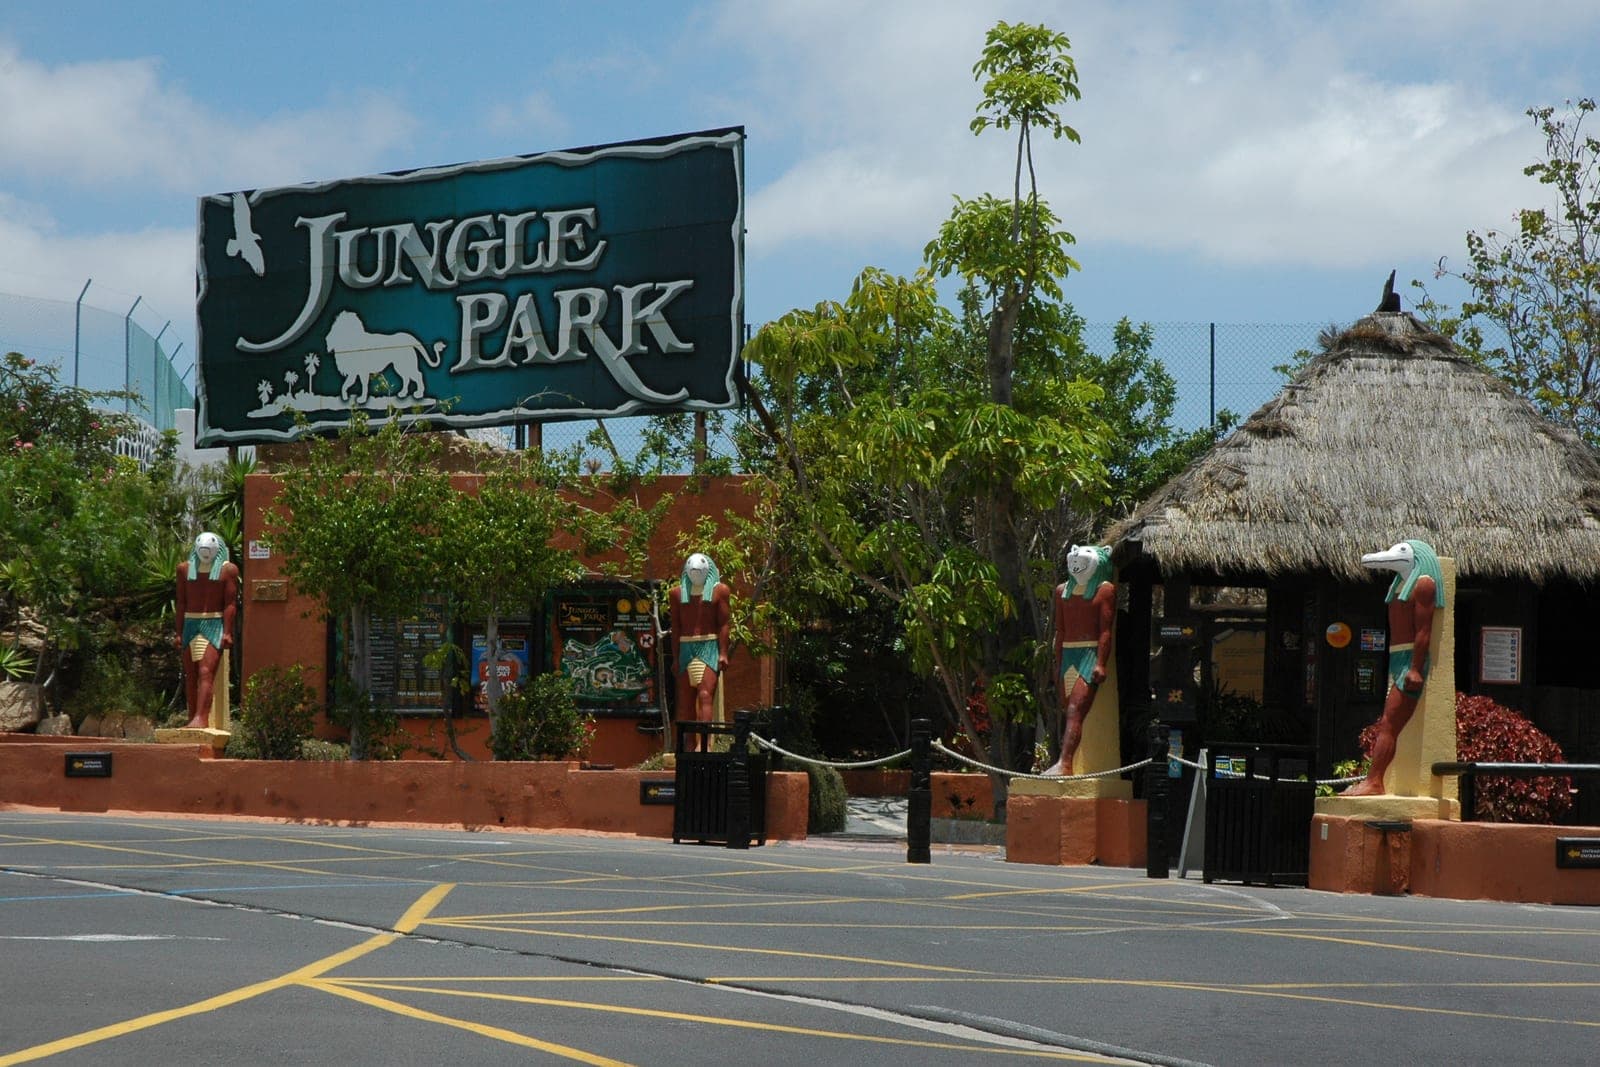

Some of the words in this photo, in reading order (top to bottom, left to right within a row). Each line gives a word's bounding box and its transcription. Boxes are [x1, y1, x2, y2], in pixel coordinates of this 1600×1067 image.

[235, 207, 607, 353] JUNGLE
[449, 280, 696, 400] PARK
[562, 606, 600, 618] JUNGLE
[583, 613, 606, 623] PARK
